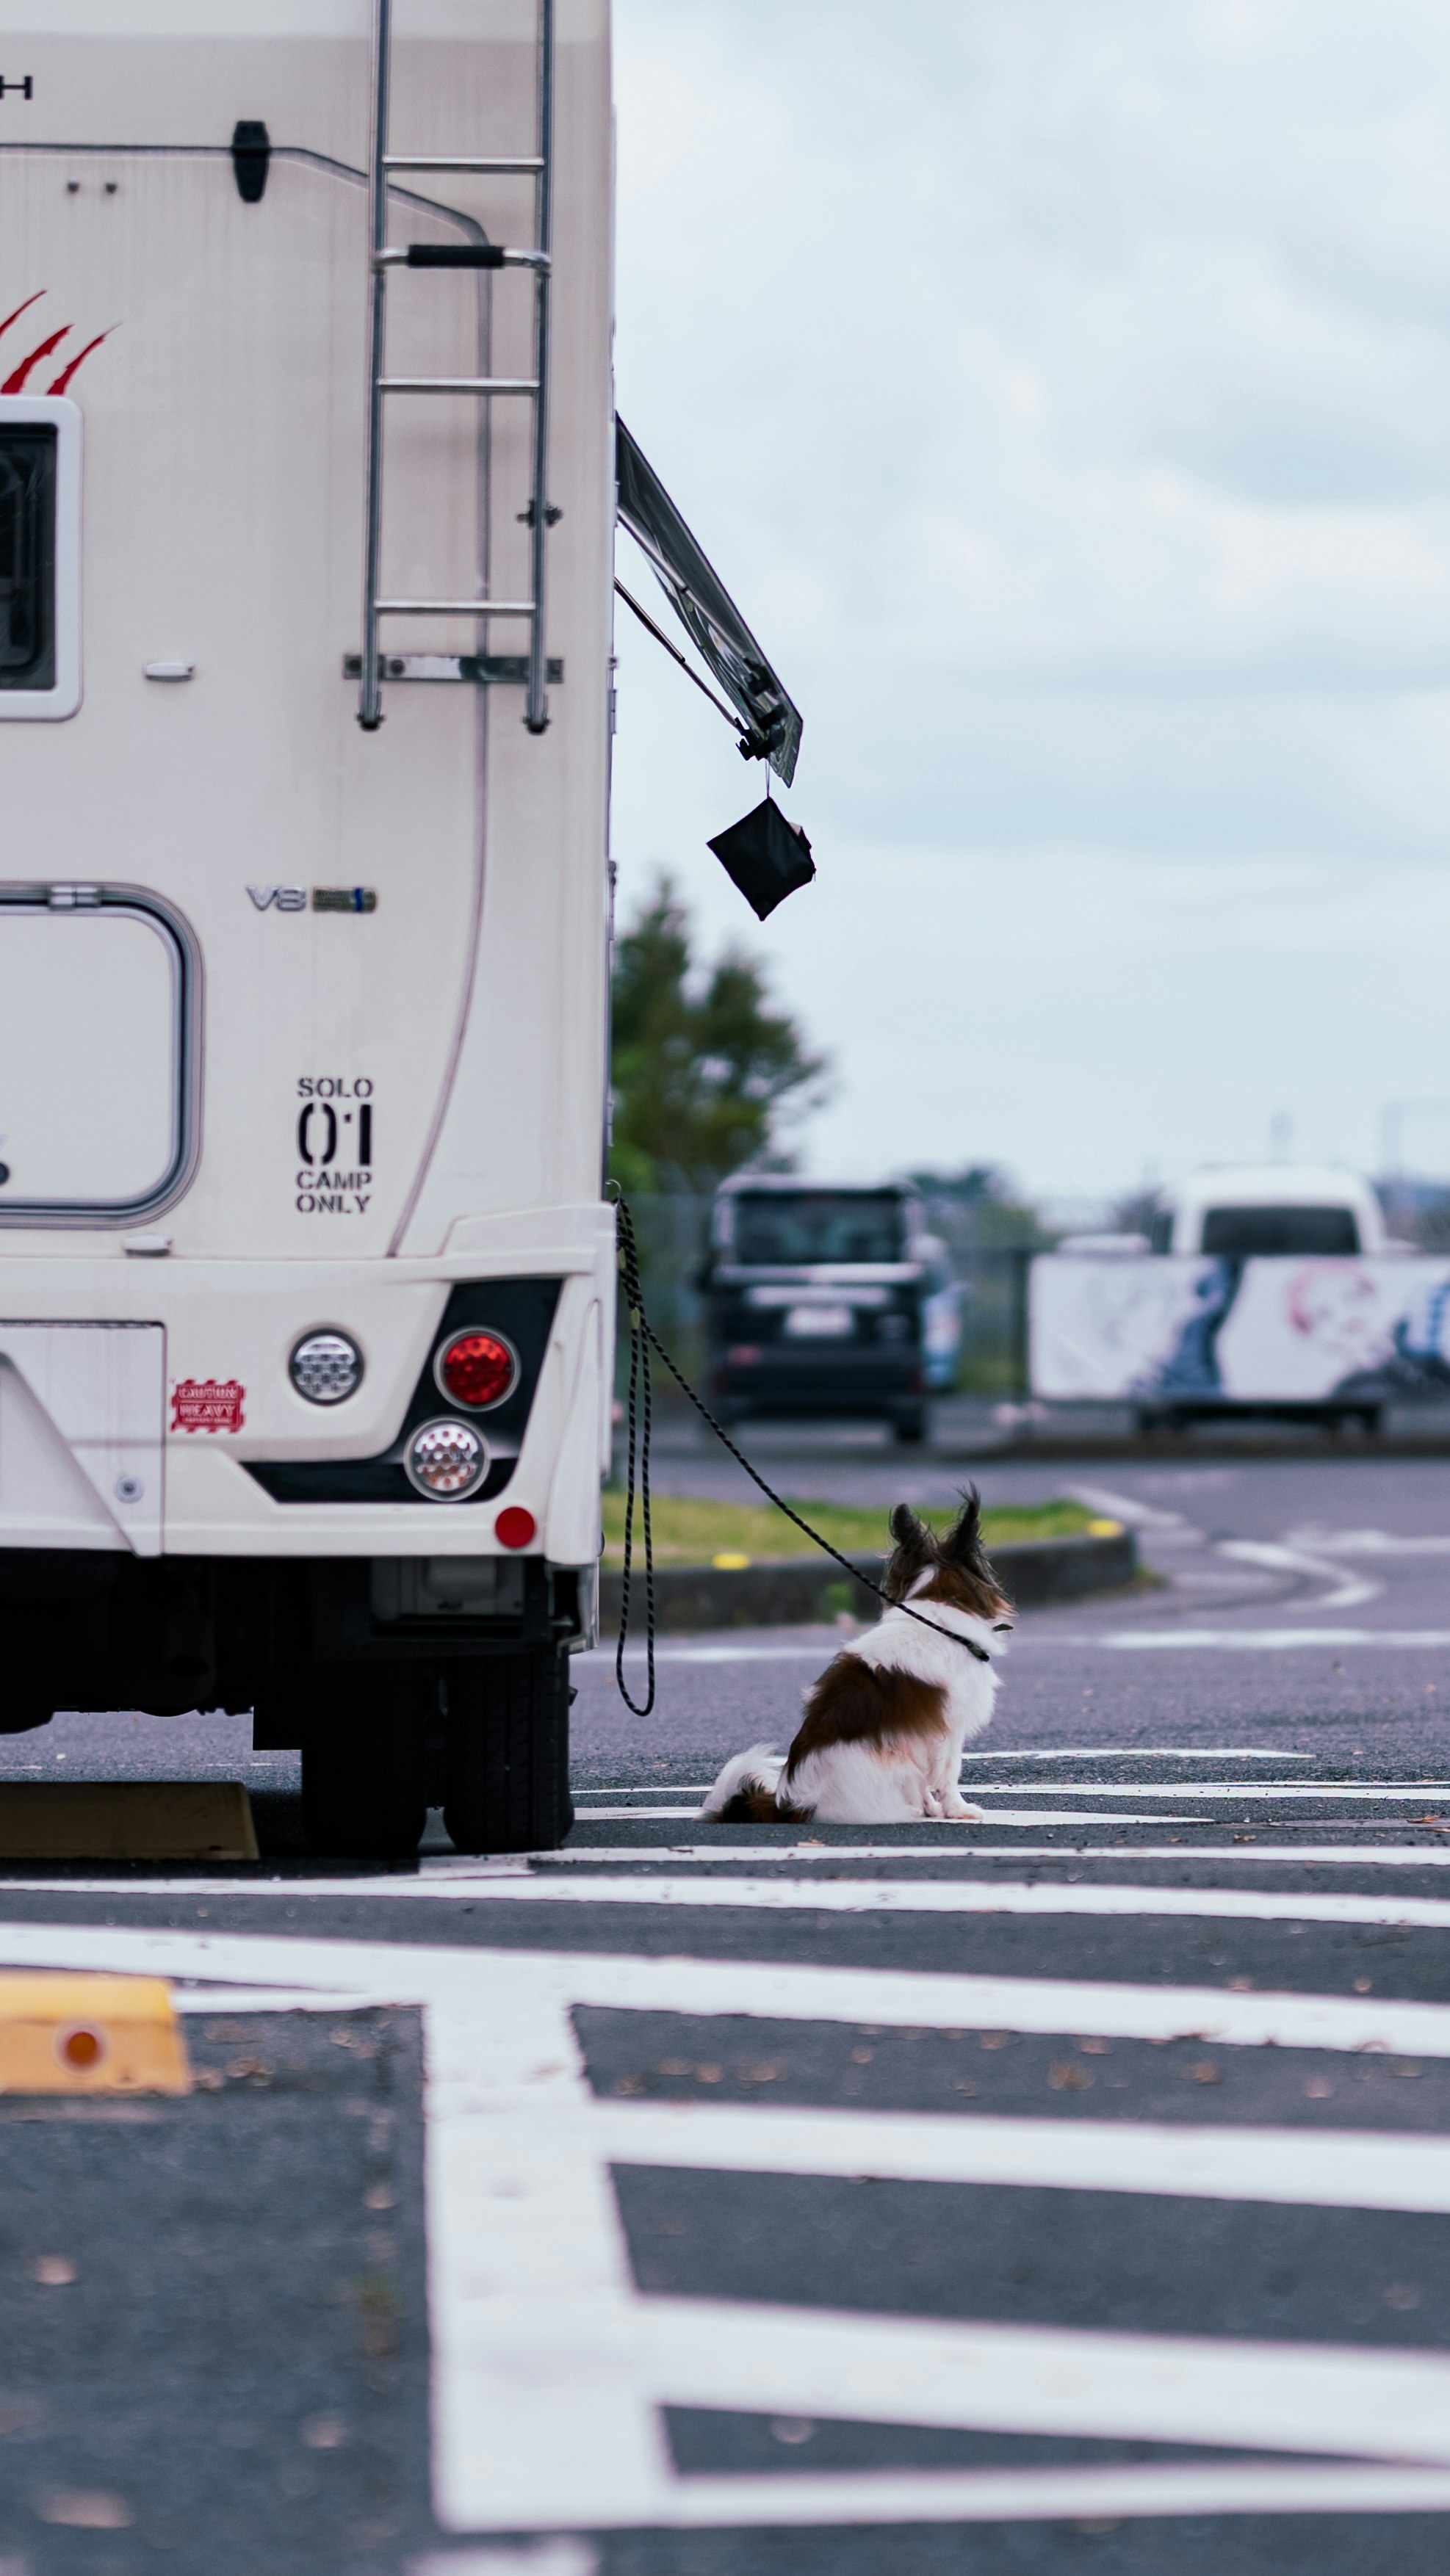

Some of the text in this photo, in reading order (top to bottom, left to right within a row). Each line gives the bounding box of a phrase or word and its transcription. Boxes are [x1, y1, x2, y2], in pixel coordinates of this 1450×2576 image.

[0, 76, 33, 100] H
[245, 886, 307, 911] V8
[297, 1077, 373, 1098] SOLO
[297, 1102, 372, 1167] 01
[296, 1171, 372, 1190] CAMP
[296, 1195, 371, 1214] ONLY
[179, 1403, 235, 1417] HEAVY
